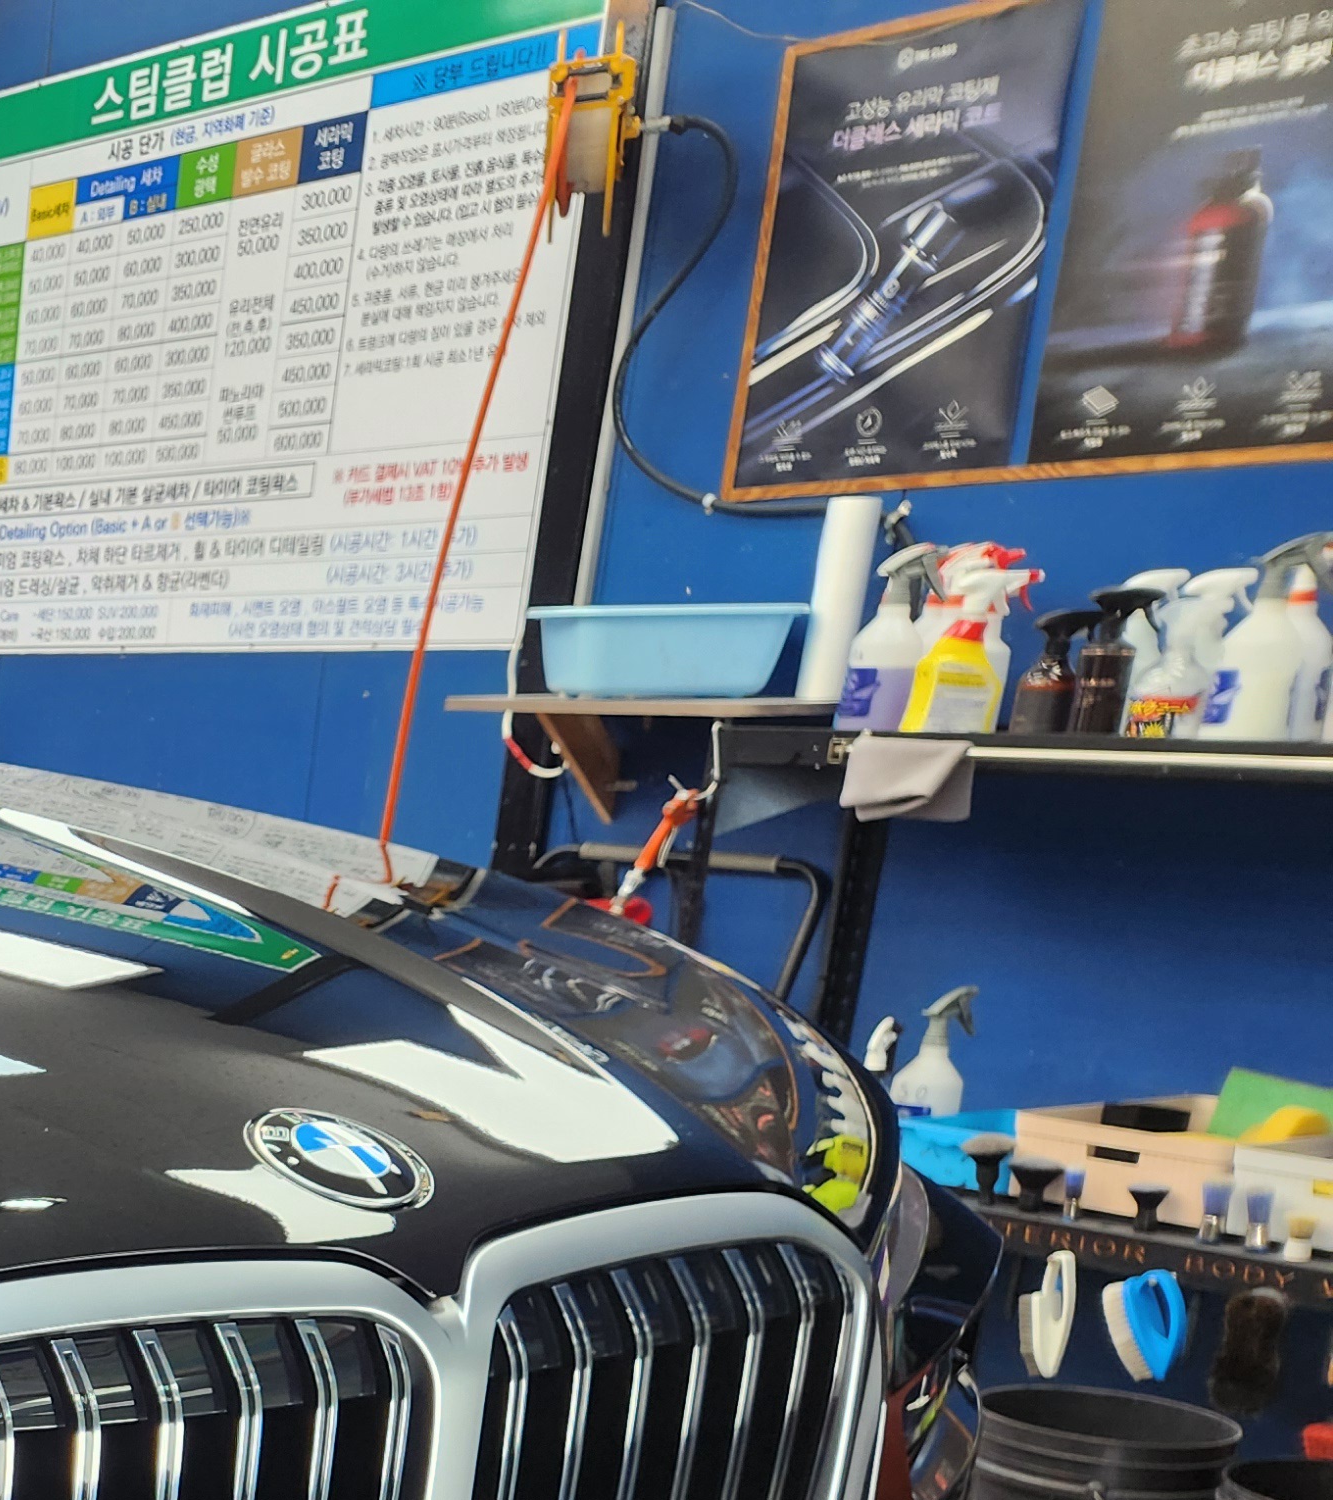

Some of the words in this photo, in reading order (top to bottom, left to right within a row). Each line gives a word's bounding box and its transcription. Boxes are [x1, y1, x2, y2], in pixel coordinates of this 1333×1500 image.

[90, 43, 234, 129] 스팀클럽
[247, 6, 372, 92] 시공표
[844, 92, 893, 126] 고성능
[895, 82, 945, 115] 유리막
[107, 137, 134, 162] 시공
[137, 129, 165, 156] 단가
[248, 103, 276, 128] 기준)
[313, 120, 354, 150] 세라믹
[902, 105, 962, 143] 세라믹
[195, 152, 219, 176] 수성
[316, 145, 346, 173] 코팅
[89, 171, 136, 199] Detailing
[140, 165, 163, 188] 세차
[193, 175, 217, 198] 광택
[300, 184, 352, 211] 300,000
[177, 210, 224, 236] 250,000
[297, 220, 348, 246] 350,000
[174, 244, 221, 269] 300,000
[236, 232, 280, 257] 50,000
[293, 256, 344, 281] 400,000
[171, 278, 217, 301] 350,000
[289, 291, 340, 316] 450,000
[168, 311, 214, 334] 400,000
[223, 335, 272, 358] 120,000
[284, 327, 335, 350] 350,000
[281, 361, 332, 384] 450,000
[277, 396, 328, 418] 500,000
[273, 430, 324, 451] 600,000
[412, 460, 438, 477] VAT
[500, 451, 530, 473] 발생
[33, 491, 76, 511] 기본왁스
[88, 489, 111, 507] 실내
[115, 486, 137, 505] 기본
[141, 482, 191, 502] 살균세차
[202, 478, 242, 498] 타이어
[245, 472, 299, 494] 코팅왁스
[49, 520, 88, 540] Option
[90, 516, 128, 536] (Basic
[20, 549, 65, 568] 코팅왁스
[76, 545, 99, 564] 차체
[103, 544, 127, 564] 하단
[130, 542, 181, 563] 타르제거
[223, 537, 264, 558] 타이어
[268, 533, 326, 556] 디테일링
[90, 573, 139, 593] 악취제거
[993, 1220, 1145, 1264] TERIOR
